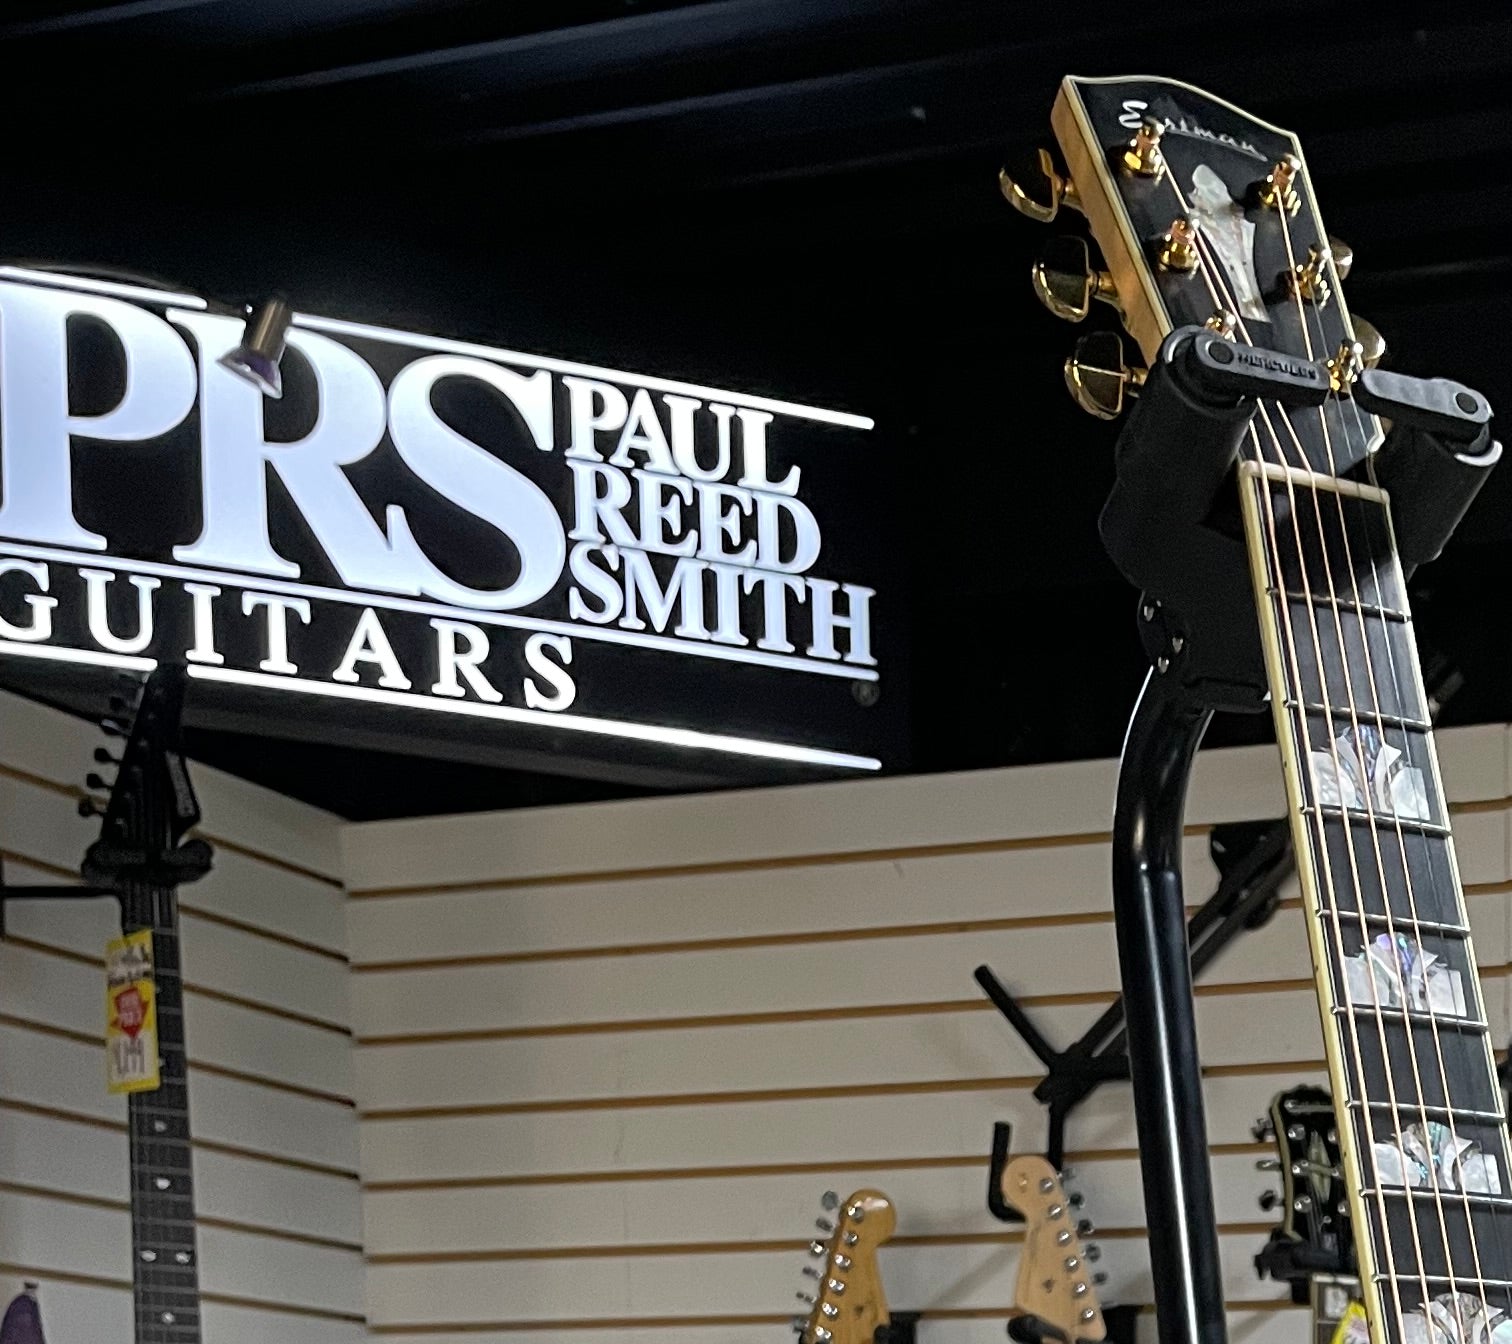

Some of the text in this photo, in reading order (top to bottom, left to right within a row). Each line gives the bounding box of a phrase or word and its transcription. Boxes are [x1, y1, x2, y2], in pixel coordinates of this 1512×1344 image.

[0, 282, 567, 610] PRS
[562, 375, 801, 497] PAUL
[566, 458, 821, 575] REED
[0, 557, 577, 712] GUITARS
[568, 540, 878, 666] SMITH
